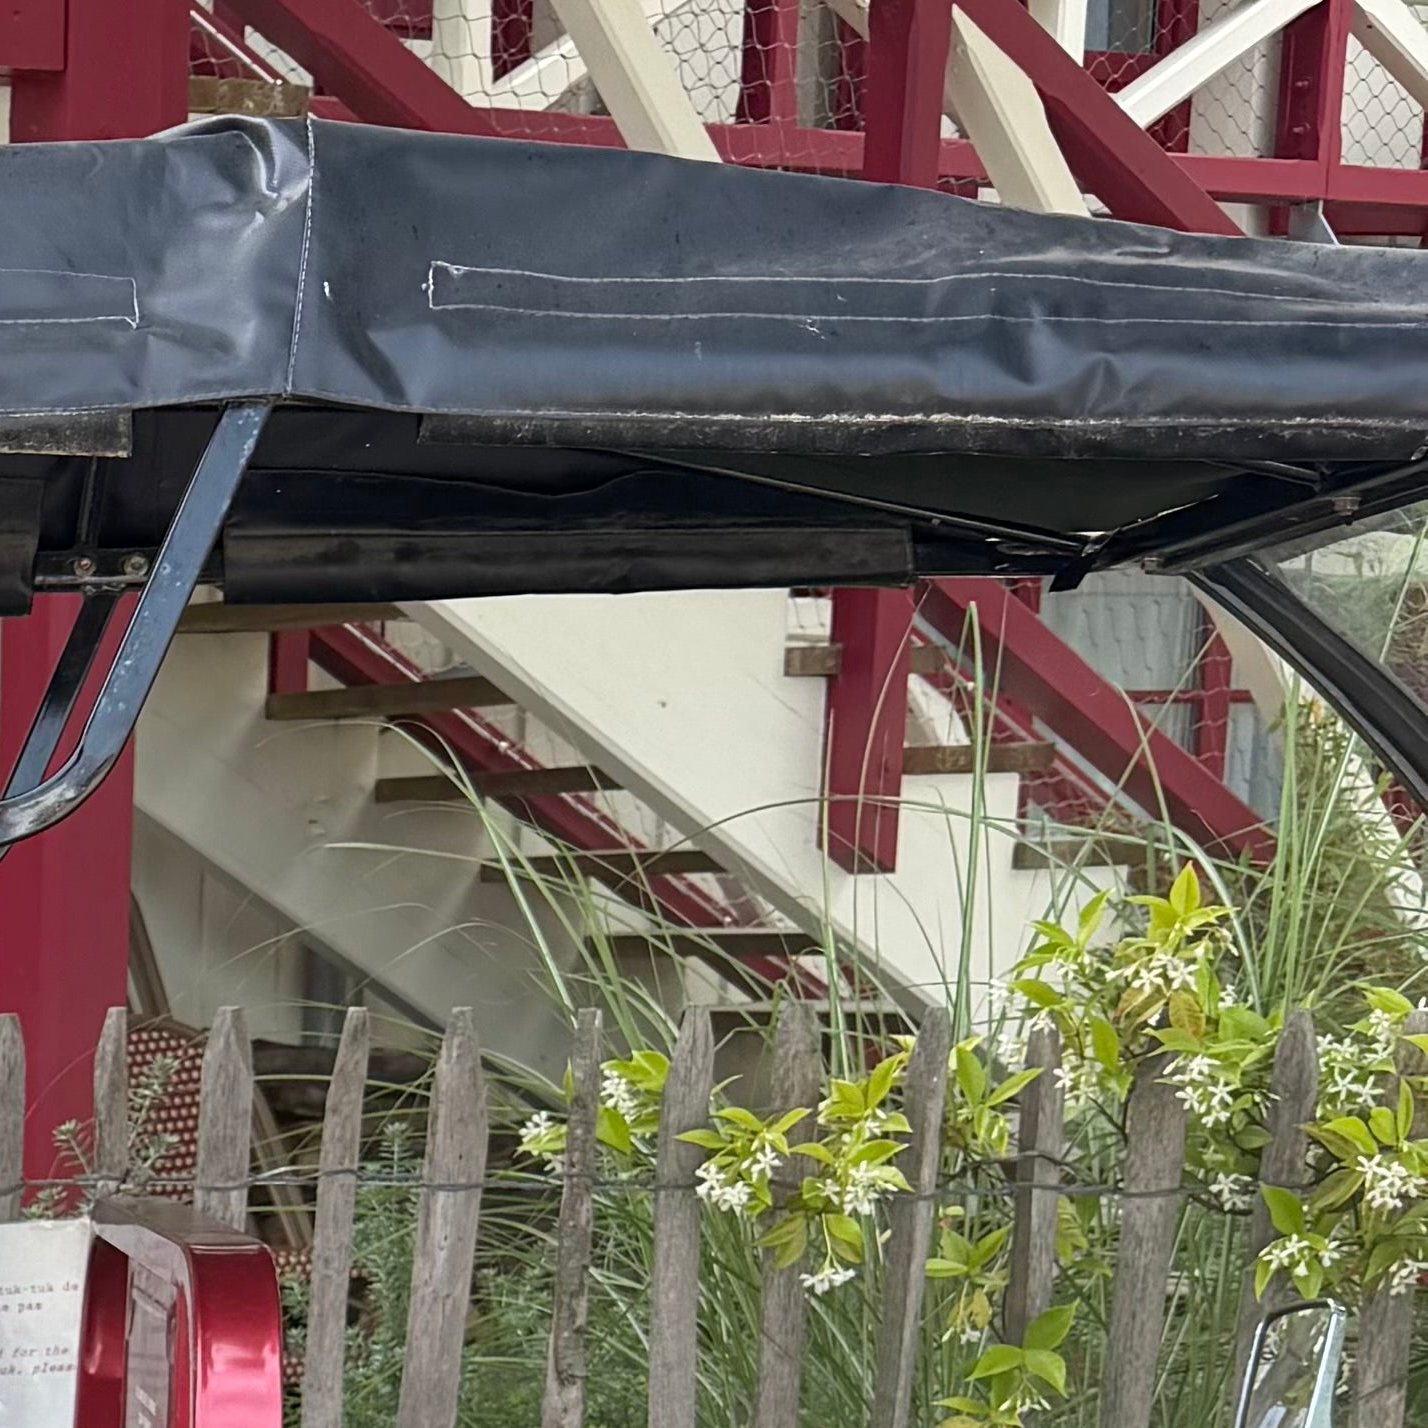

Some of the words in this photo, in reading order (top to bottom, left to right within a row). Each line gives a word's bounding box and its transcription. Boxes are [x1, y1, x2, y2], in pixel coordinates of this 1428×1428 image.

[63, 1281, 79, 1291] de
[18, 1302, 42, 1314] pas
[12, 1348, 36, 1359] for
[46, 1345, 69, 1357] the
